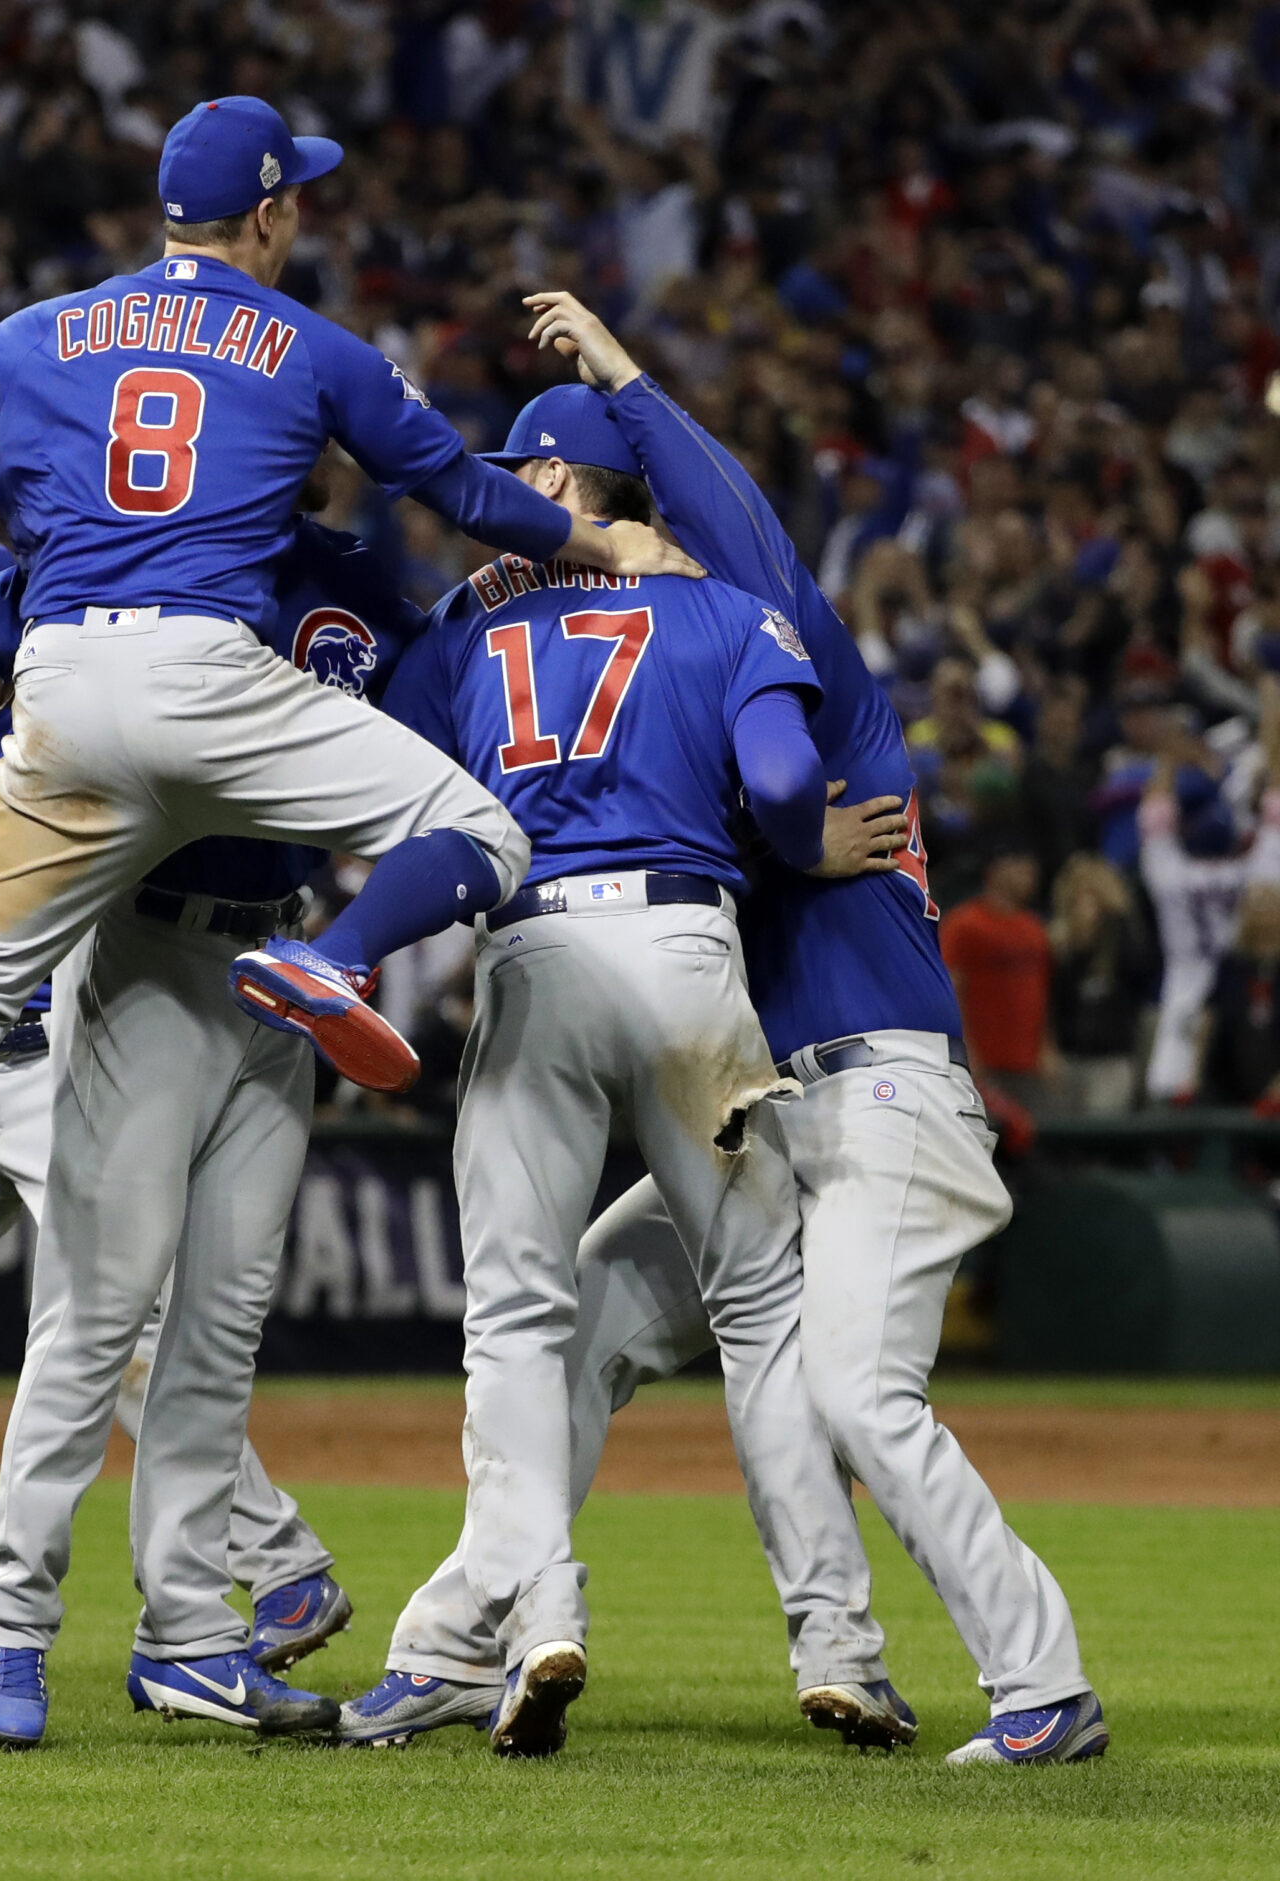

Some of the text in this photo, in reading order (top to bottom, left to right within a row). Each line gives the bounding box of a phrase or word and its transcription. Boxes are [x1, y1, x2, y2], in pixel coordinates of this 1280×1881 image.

[57, 292, 298, 379] COGHLAN
[105, 367, 205, 516] 8
[486, 606, 654, 775] 17
